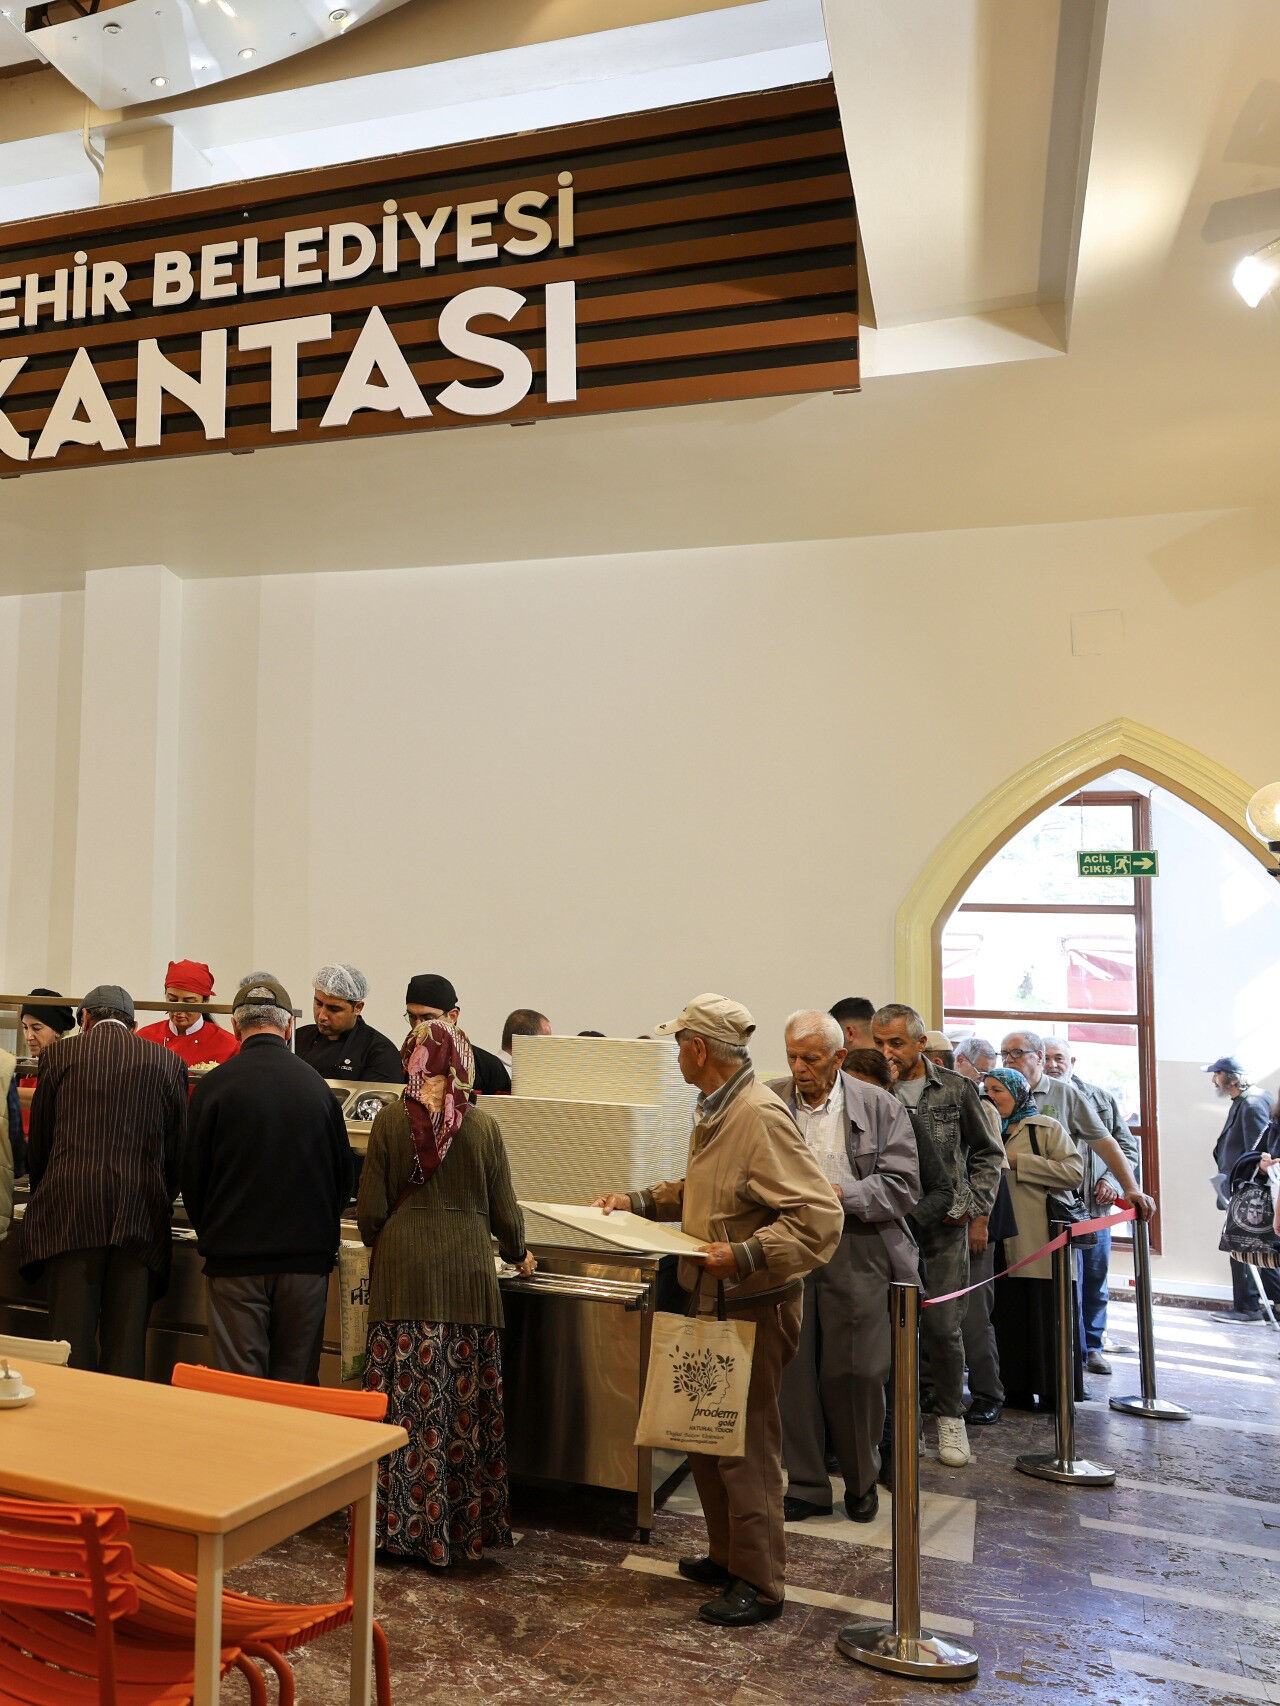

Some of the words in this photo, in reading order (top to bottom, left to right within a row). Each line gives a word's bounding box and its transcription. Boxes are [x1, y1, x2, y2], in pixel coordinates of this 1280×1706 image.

[152, 171, 574, 307] BELEDİYESİ
[1084, 853, 1110, 863] ACİL
[1081, 865, 1113, 874] ÇIKIŞ
[691, 1407, 739, 1421] proderm
